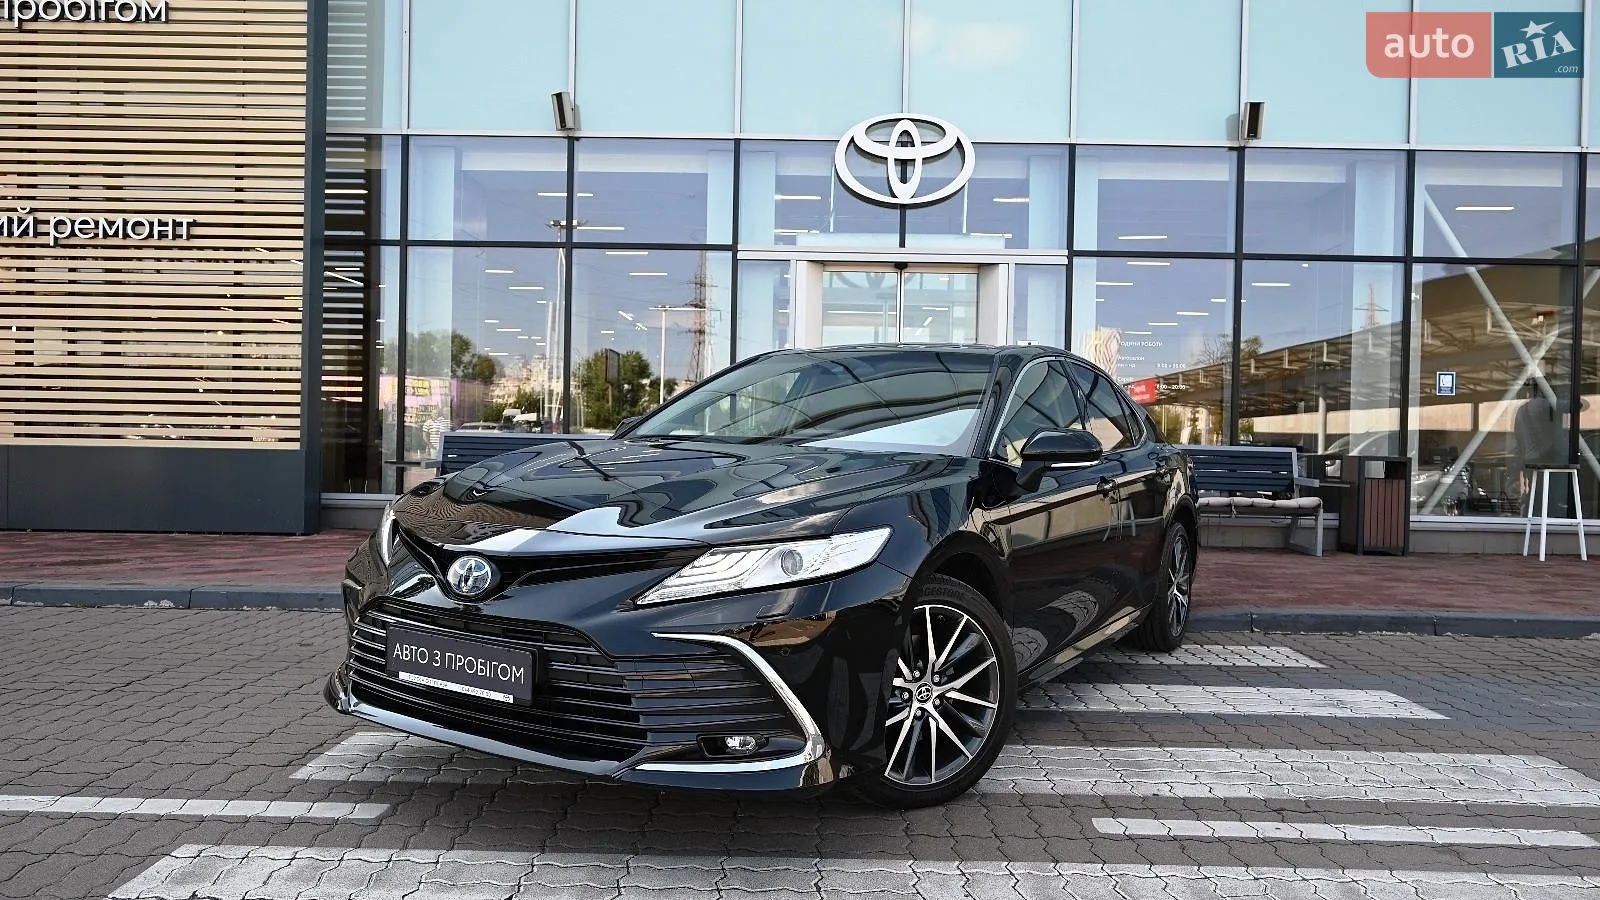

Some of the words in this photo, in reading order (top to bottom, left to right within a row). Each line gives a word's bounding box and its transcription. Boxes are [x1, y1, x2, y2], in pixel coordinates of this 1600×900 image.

[50, 214, 195, 246] ремонт
[393, 642, 429, 664] АВТО
[445, 652, 525, 685] ПРОБІГОМ
